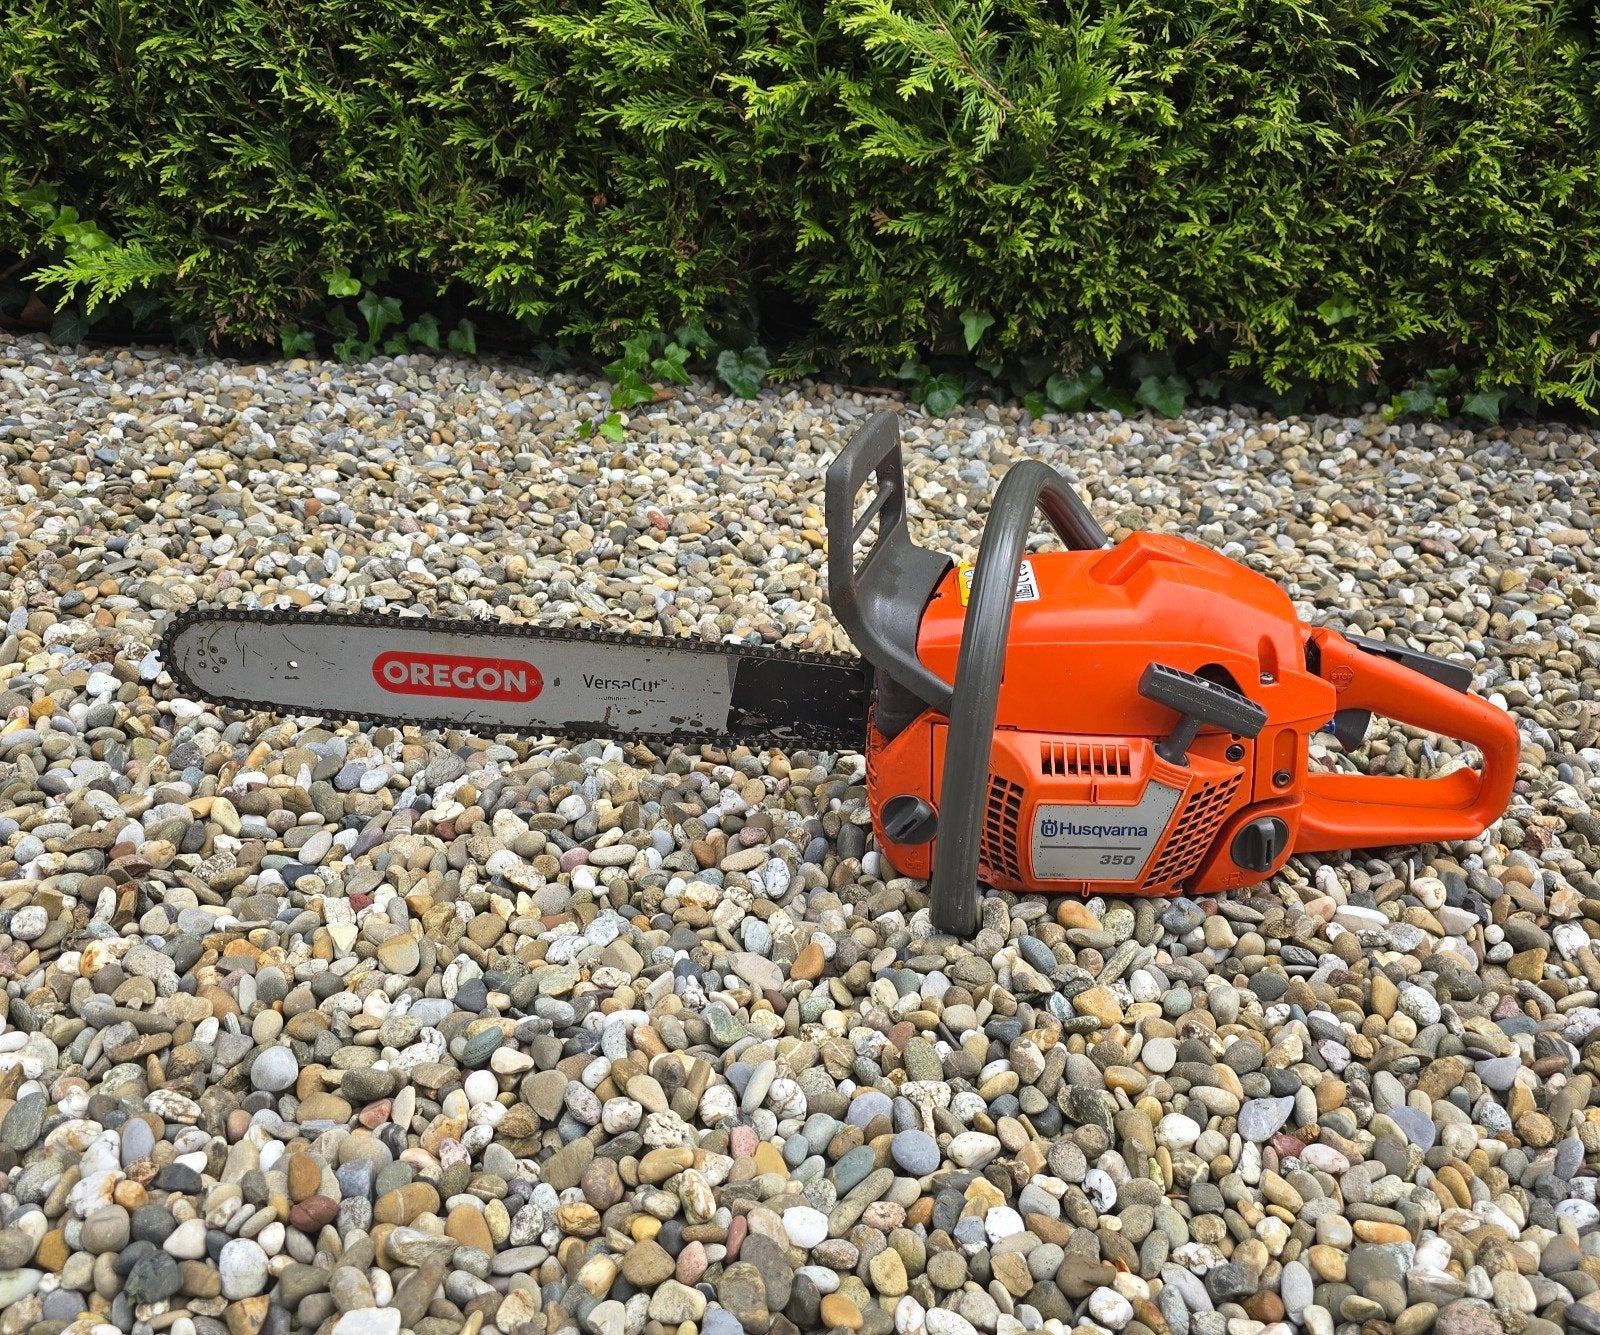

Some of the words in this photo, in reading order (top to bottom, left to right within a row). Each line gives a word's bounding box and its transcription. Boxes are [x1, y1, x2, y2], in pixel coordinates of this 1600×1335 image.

[383, 660, 527, 693] OREGON
[582, 673, 661, 693] VersaCut
[1060, 822, 1148, 838] Husqvarna
[1099, 854, 1136, 866] 350
